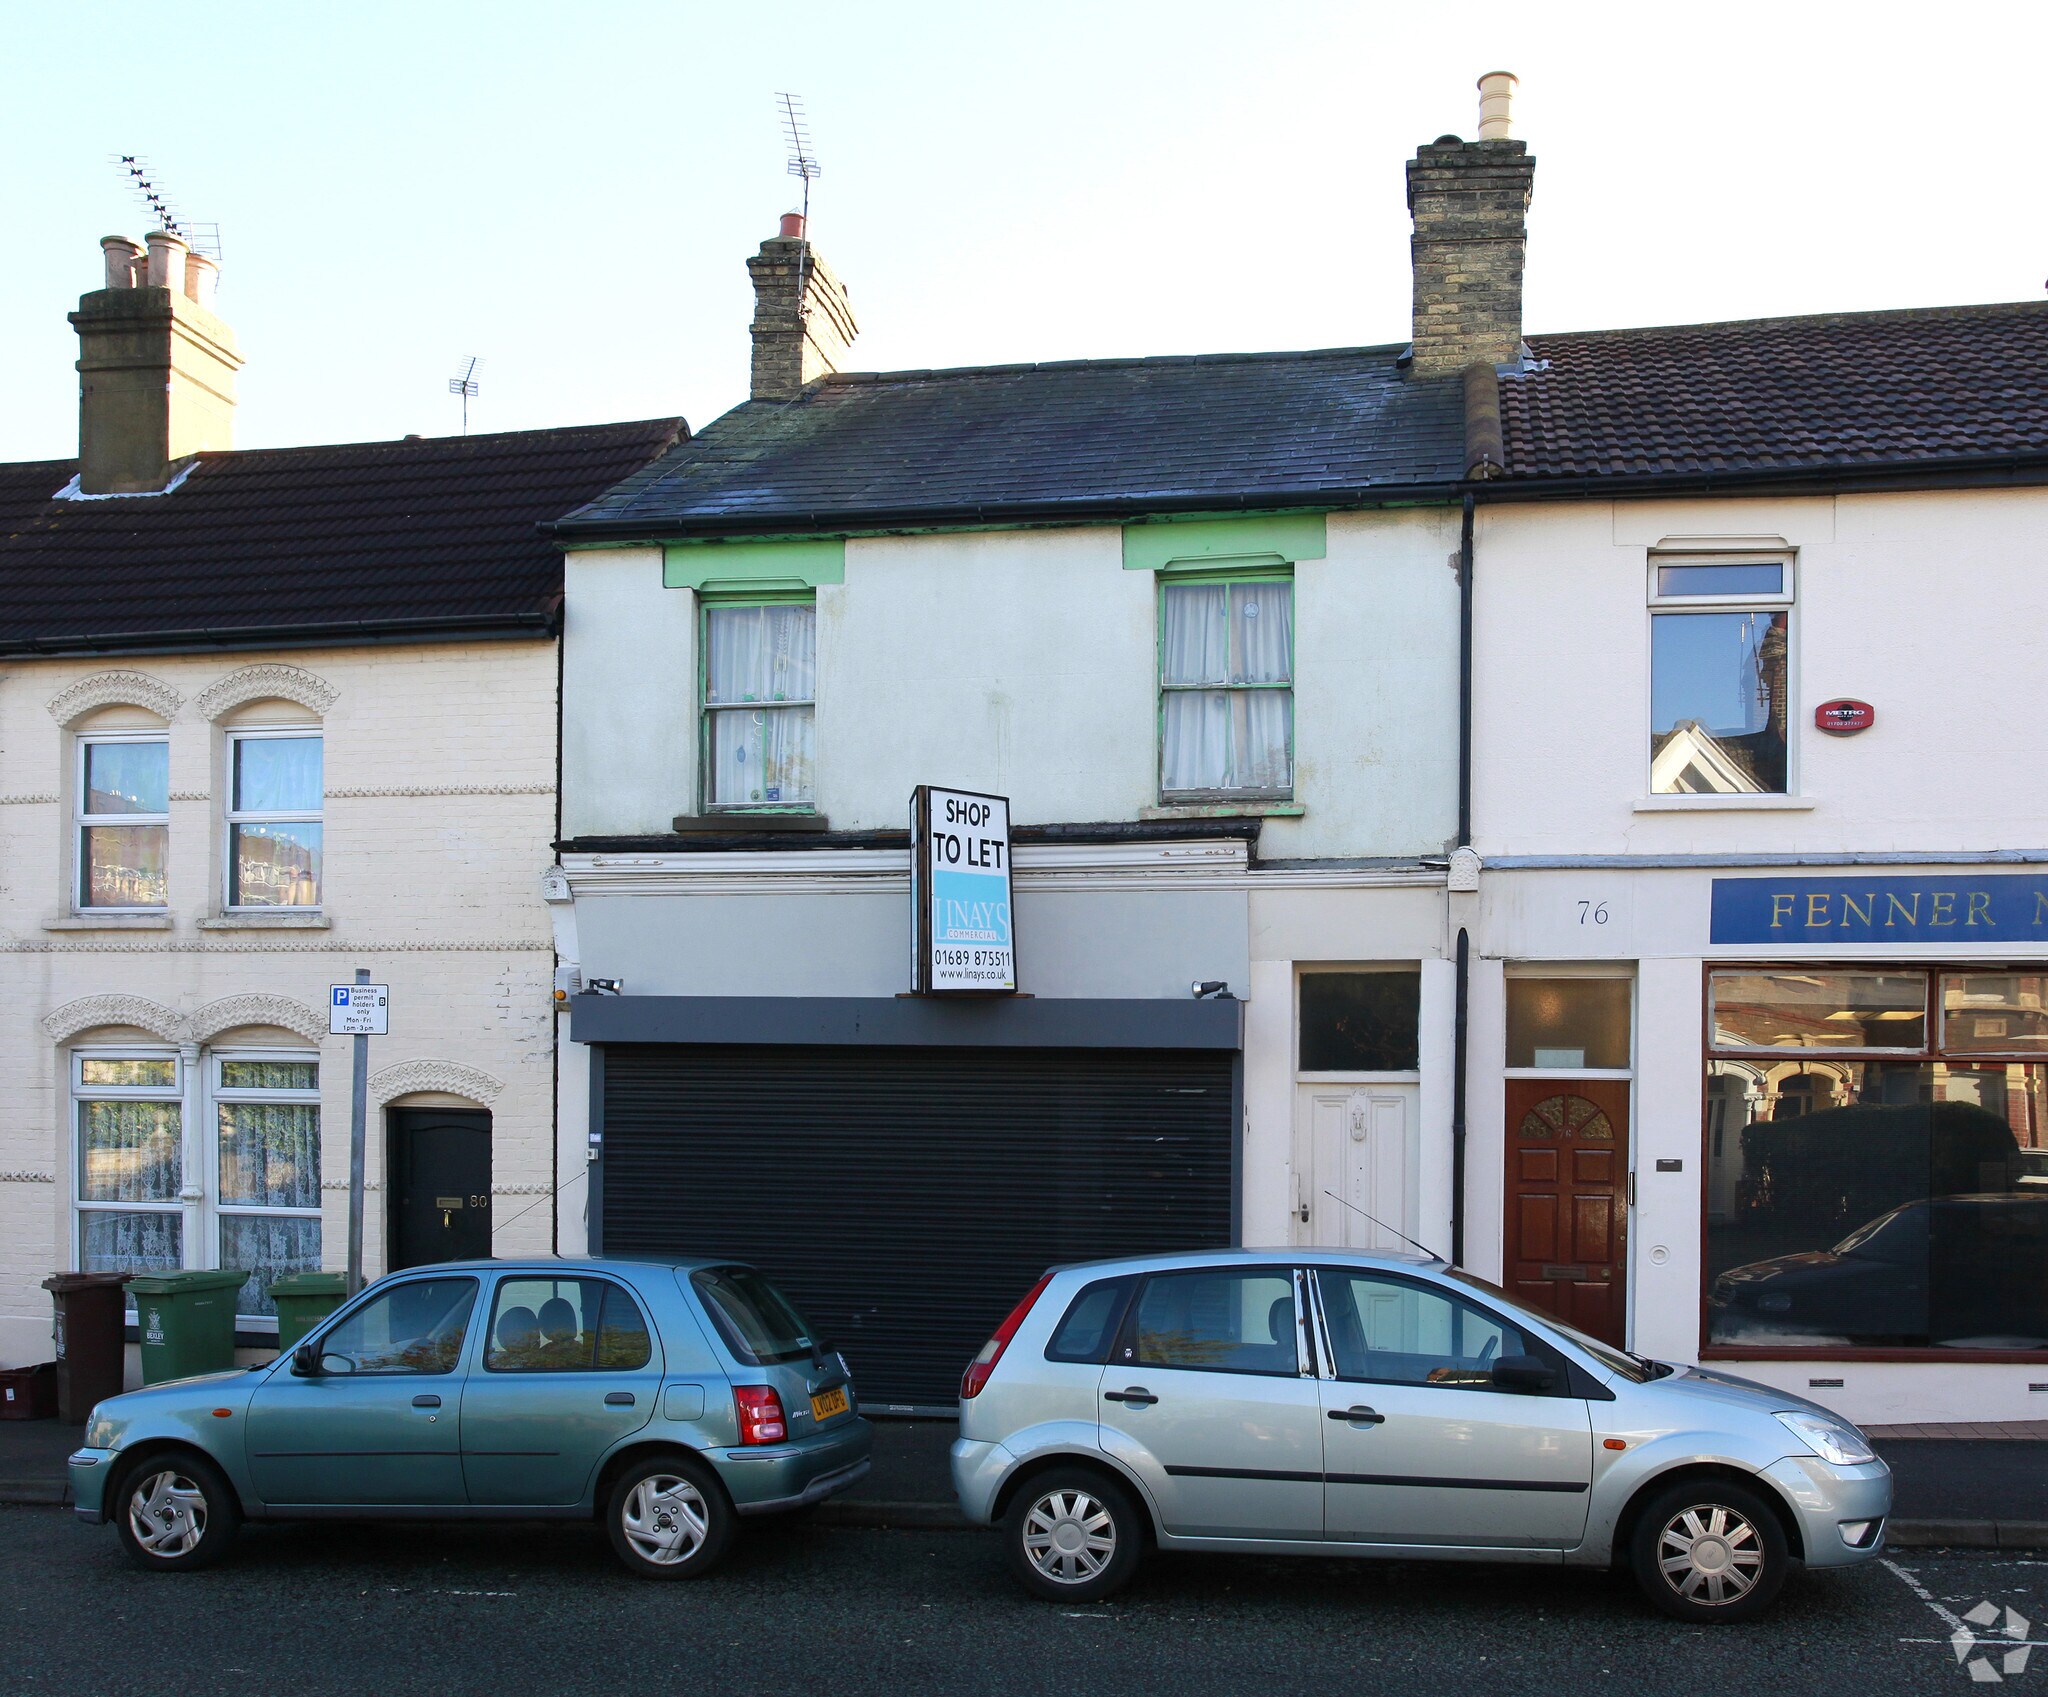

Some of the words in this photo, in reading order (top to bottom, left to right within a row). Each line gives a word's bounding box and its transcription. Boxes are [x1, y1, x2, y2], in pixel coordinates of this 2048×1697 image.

[946, 798, 991, 828] SHOP
[932, 832, 961, 864] TO
[967, 837, 1004, 869] LET
[935, 897, 1008, 942] LINAYS
[1577, 900, 1609, 925] 76
[1769, 891, 1996, 928] FENNER
[948, 929, 996, 940] COMMERCIAL
[934, 949, 970, 966] 01689
[974, 950, 1010, 967] 875511
[939, 967, 1007, 982] www.linays.co.uk
[336, 990, 347, 1004] P
[470, 1195, 487, 1208] 80
